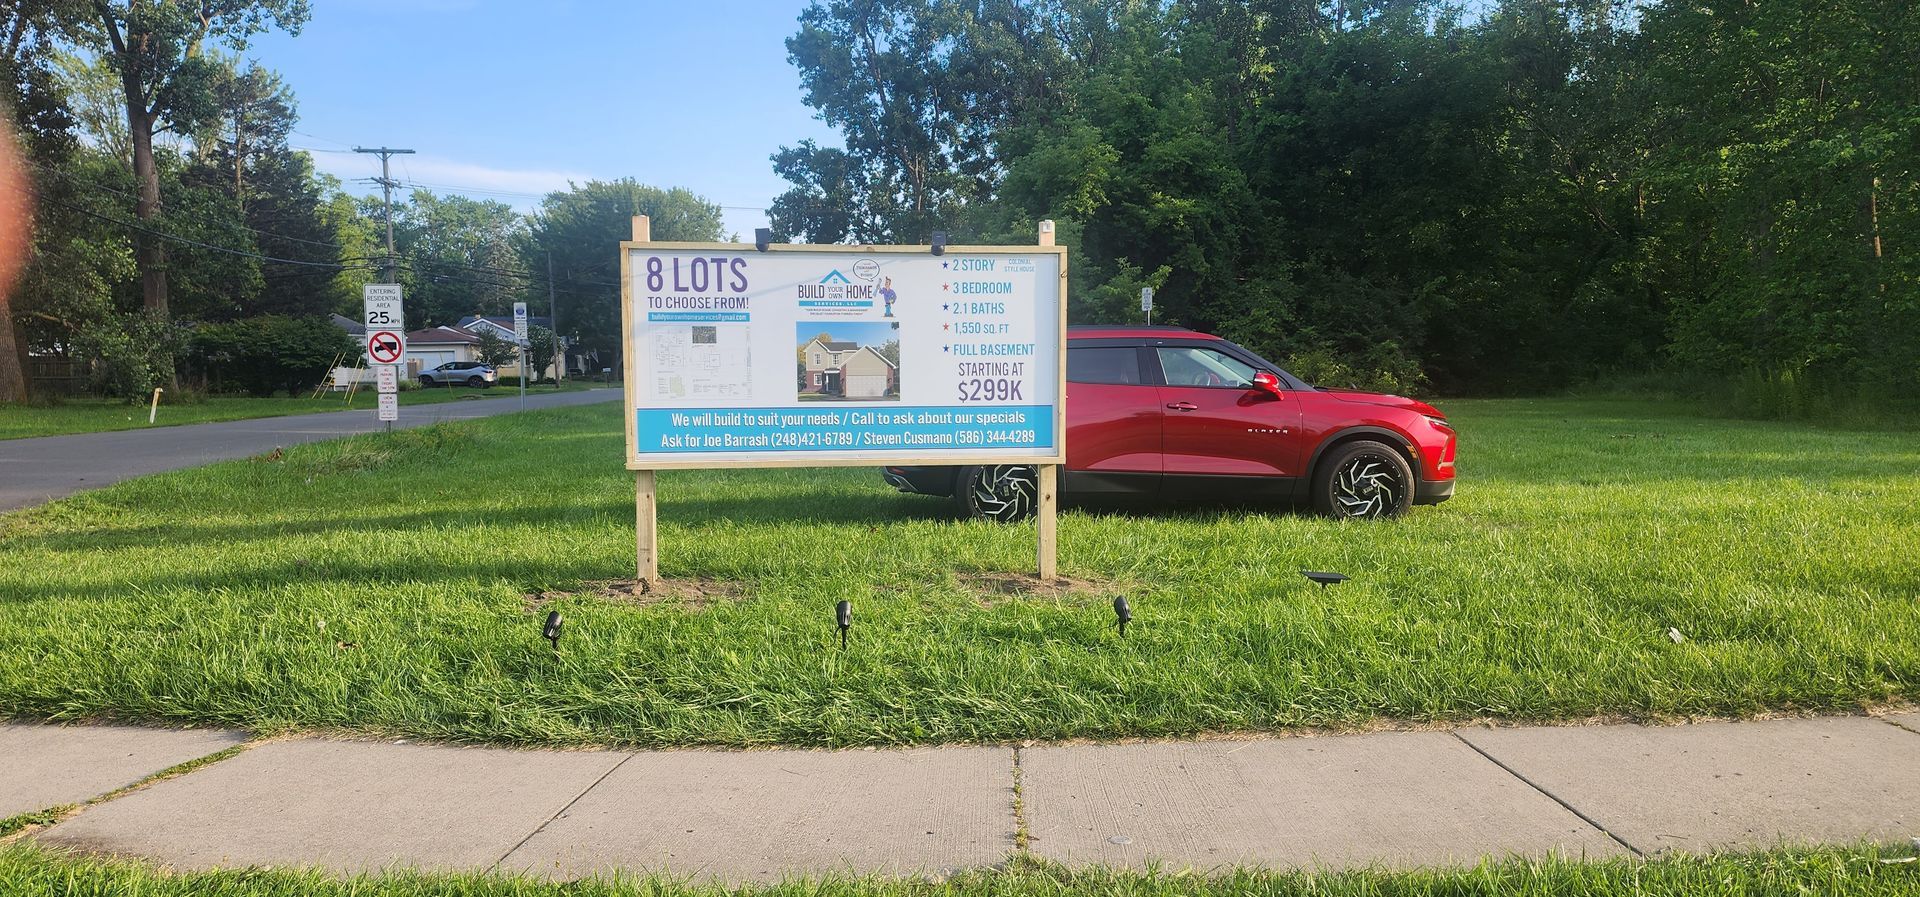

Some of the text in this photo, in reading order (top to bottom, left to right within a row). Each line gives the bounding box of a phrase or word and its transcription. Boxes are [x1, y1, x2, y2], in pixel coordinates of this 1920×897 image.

[953, 258, 996, 272] 2 STORY
[1004, 265, 1035, 273] STYLE HOUSE
[1008, 258, 1032, 266] COLONIAL
[646, 256, 748, 293] 8 LOTS
[798, 284, 825, 299] BUILD
[827, 285, 844, 293] YOUR
[846, 285, 873, 299] HOME
[953, 281, 1012, 294] 3 BEDROOM
[648, 296, 749, 309] TO CHOOSE FROM!
[953, 302, 1005, 315] 2.1 BATHS
[368, 311, 390, 324] 25
[955, 322, 1010, 336] 1,550 SQ. FT
[953, 343, 1035, 356] FULL BASEMENT
[958, 362, 1024, 376] STARTING AT
[958, 378, 1023, 403] $299K
[672, 413, 690, 427] We
[692, 412, 712, 427] will
[714, 412, 741, 426] build
[743, 413, 755, 426] to
[757, 412, 779, 426] suit
[780, 415, 805, 428] your
[807, 412, 840, 425] needs
[851, 412, 874, 425] Call
[877, 413, 890, 425] to
[893, 412, 914, 424] ask
[918, 411, 952, 424] about
[954, 413, 974, 424] our
[976, 411, 1025, 426] specials
[661, 434, 683, 448] Ask
[684, 433, 702, 447] for
[703, 433, 722, 447] Joe
[724, 433, 769, 447] Barrash
[770, 432, 853, 447] (248)421-6789
[864, 432, 902, 445] Steven
[903, 431, 952, 444] Cusmano
[954, 430, 984, 445] (586)
[986, 430, 1035, 443] 344-4289
